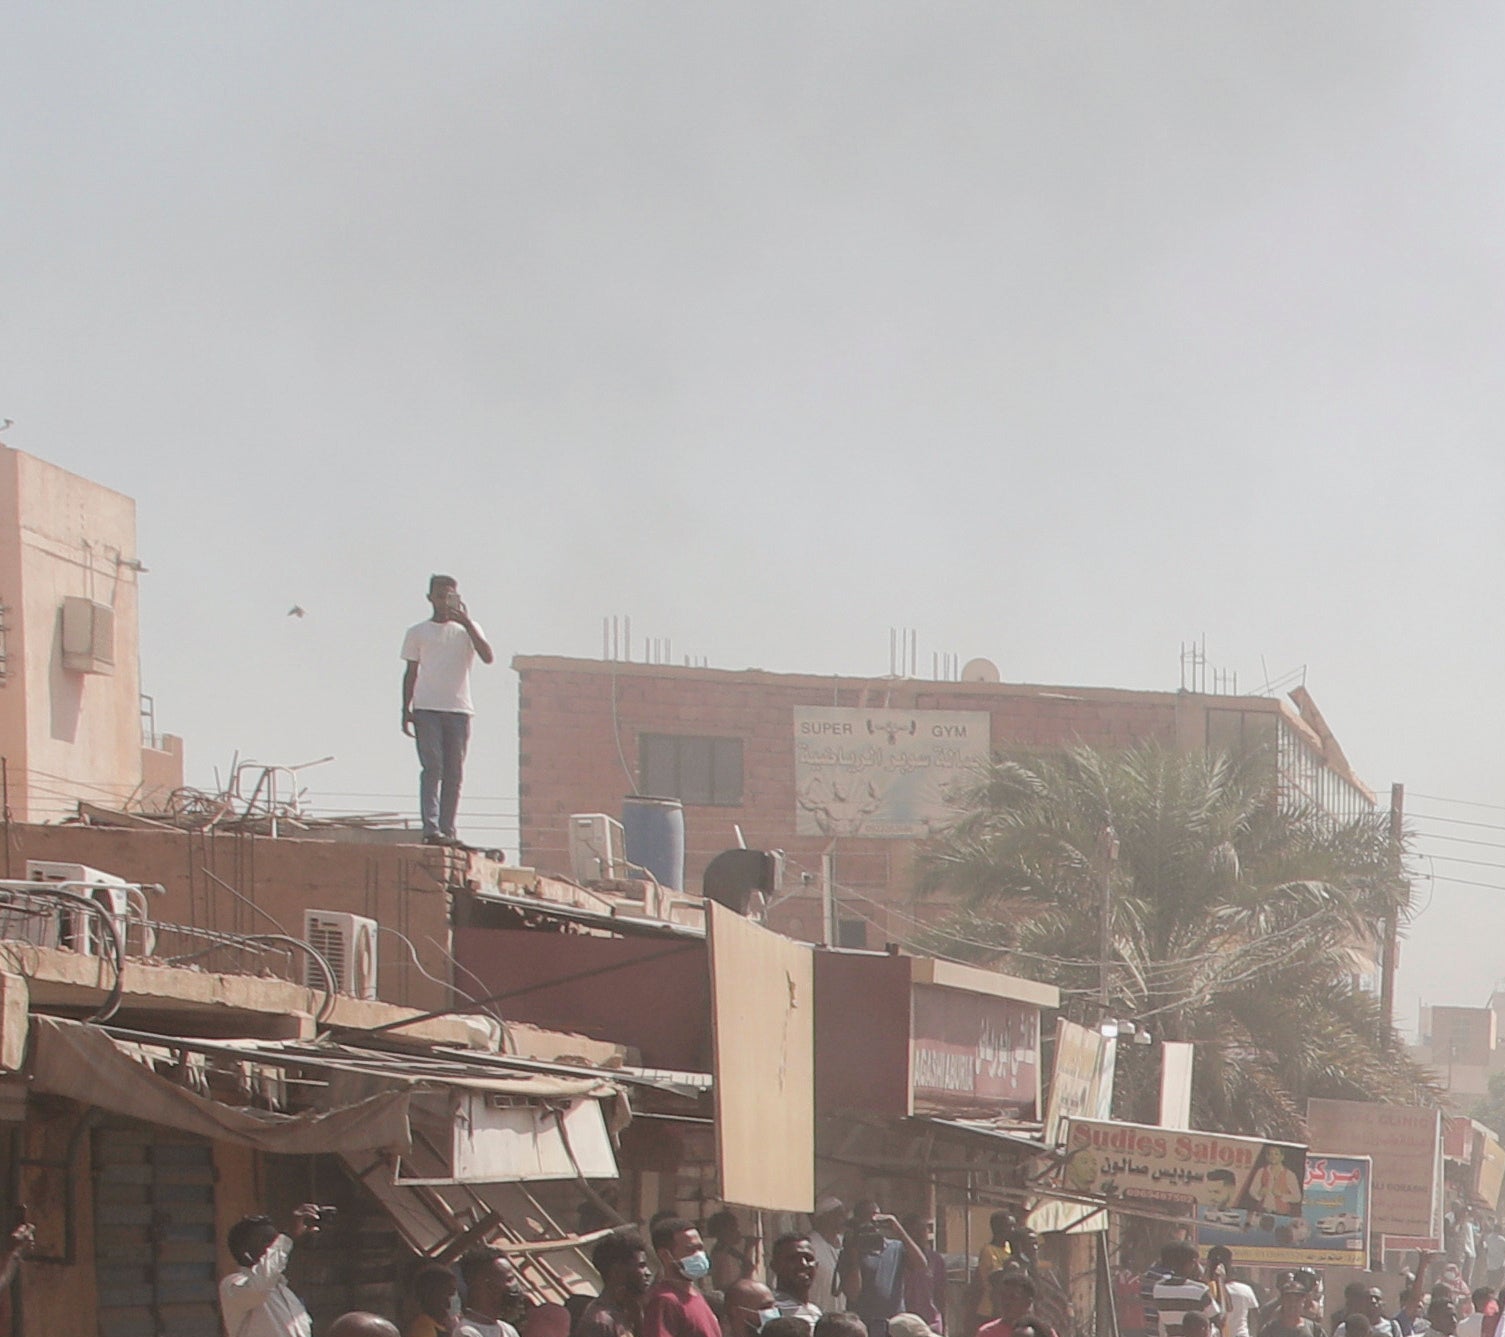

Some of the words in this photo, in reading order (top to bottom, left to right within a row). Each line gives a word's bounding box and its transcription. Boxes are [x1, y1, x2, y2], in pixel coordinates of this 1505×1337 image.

[801, 721, 853, 735] SUPER
[932, 726, 968, 738] GYM
[1072, 1123, 1167, 1159] Sudies
[1174, 1133, 1253, 1168] Salon
